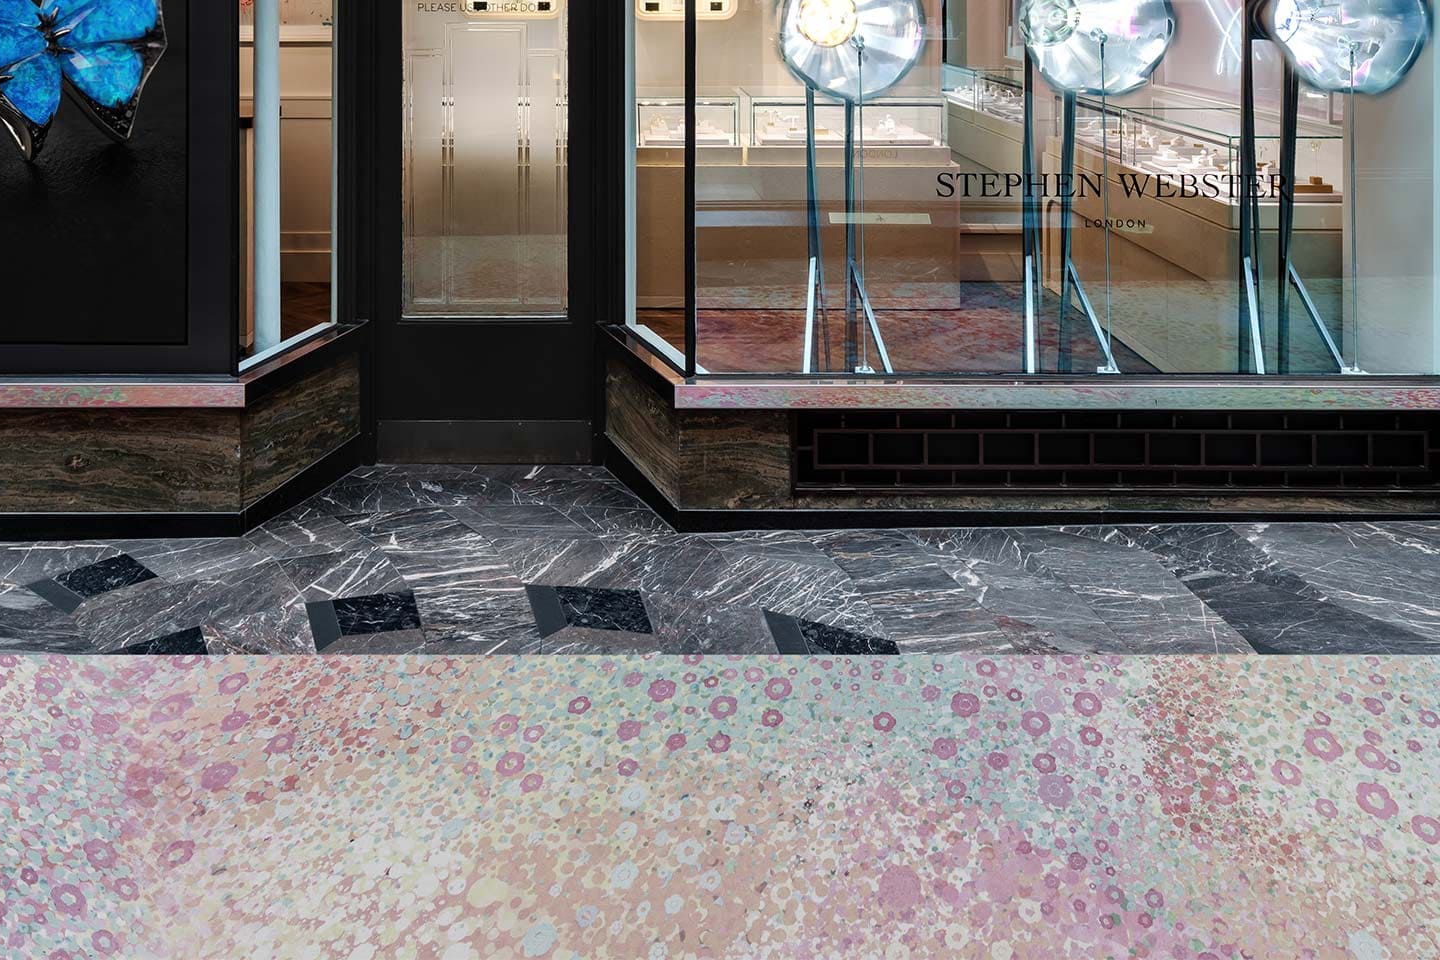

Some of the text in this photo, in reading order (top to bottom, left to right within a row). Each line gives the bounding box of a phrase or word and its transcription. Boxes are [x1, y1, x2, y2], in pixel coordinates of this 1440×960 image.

[417, 1, 457, 13] PLEASE
[459, 1, 480, 13] US
[935, 172, 1294, 203] STEPHEN WEBSTER
[1085, 218, 1147, 229] LONDON
